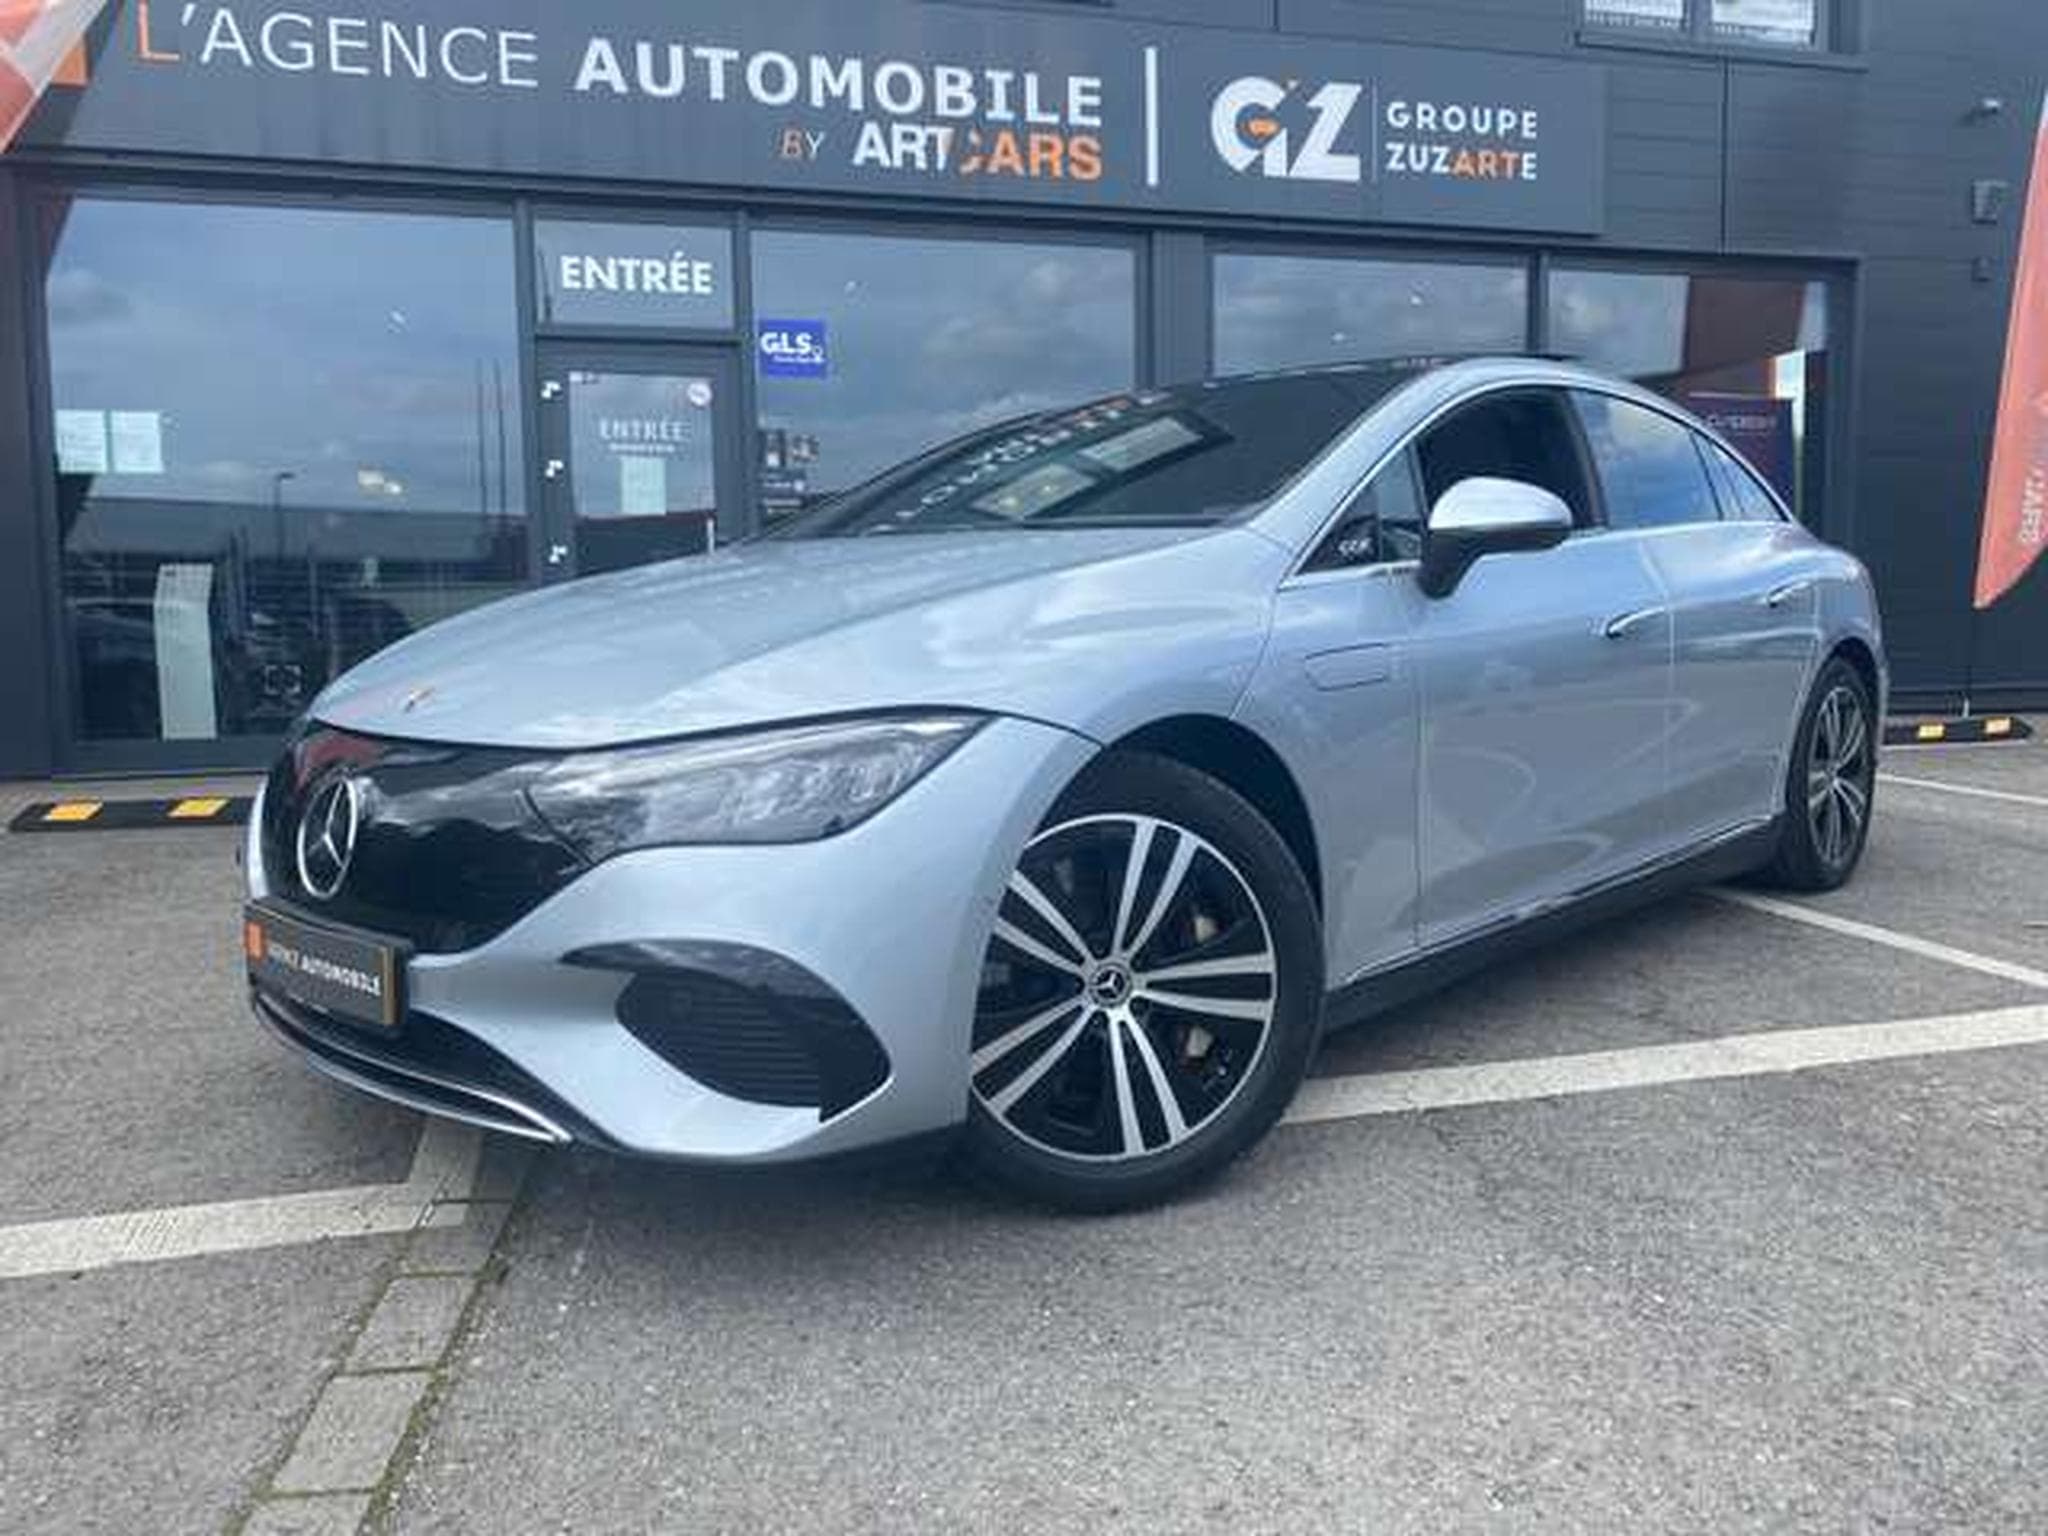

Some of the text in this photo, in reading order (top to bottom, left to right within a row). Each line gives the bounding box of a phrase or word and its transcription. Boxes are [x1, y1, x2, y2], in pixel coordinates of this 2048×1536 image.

[137, 0, 1102, 127] L'AGENCE AUTOMOBILE
[1385, 102, 1538, 138] GROUPE
[780, 129, 825, 160] BY
[1385, 143, 1538, 180] ZUZARTE
[560, 250, 714, 294] ENTRÉE
[760, 331, 812, 354] GLS
